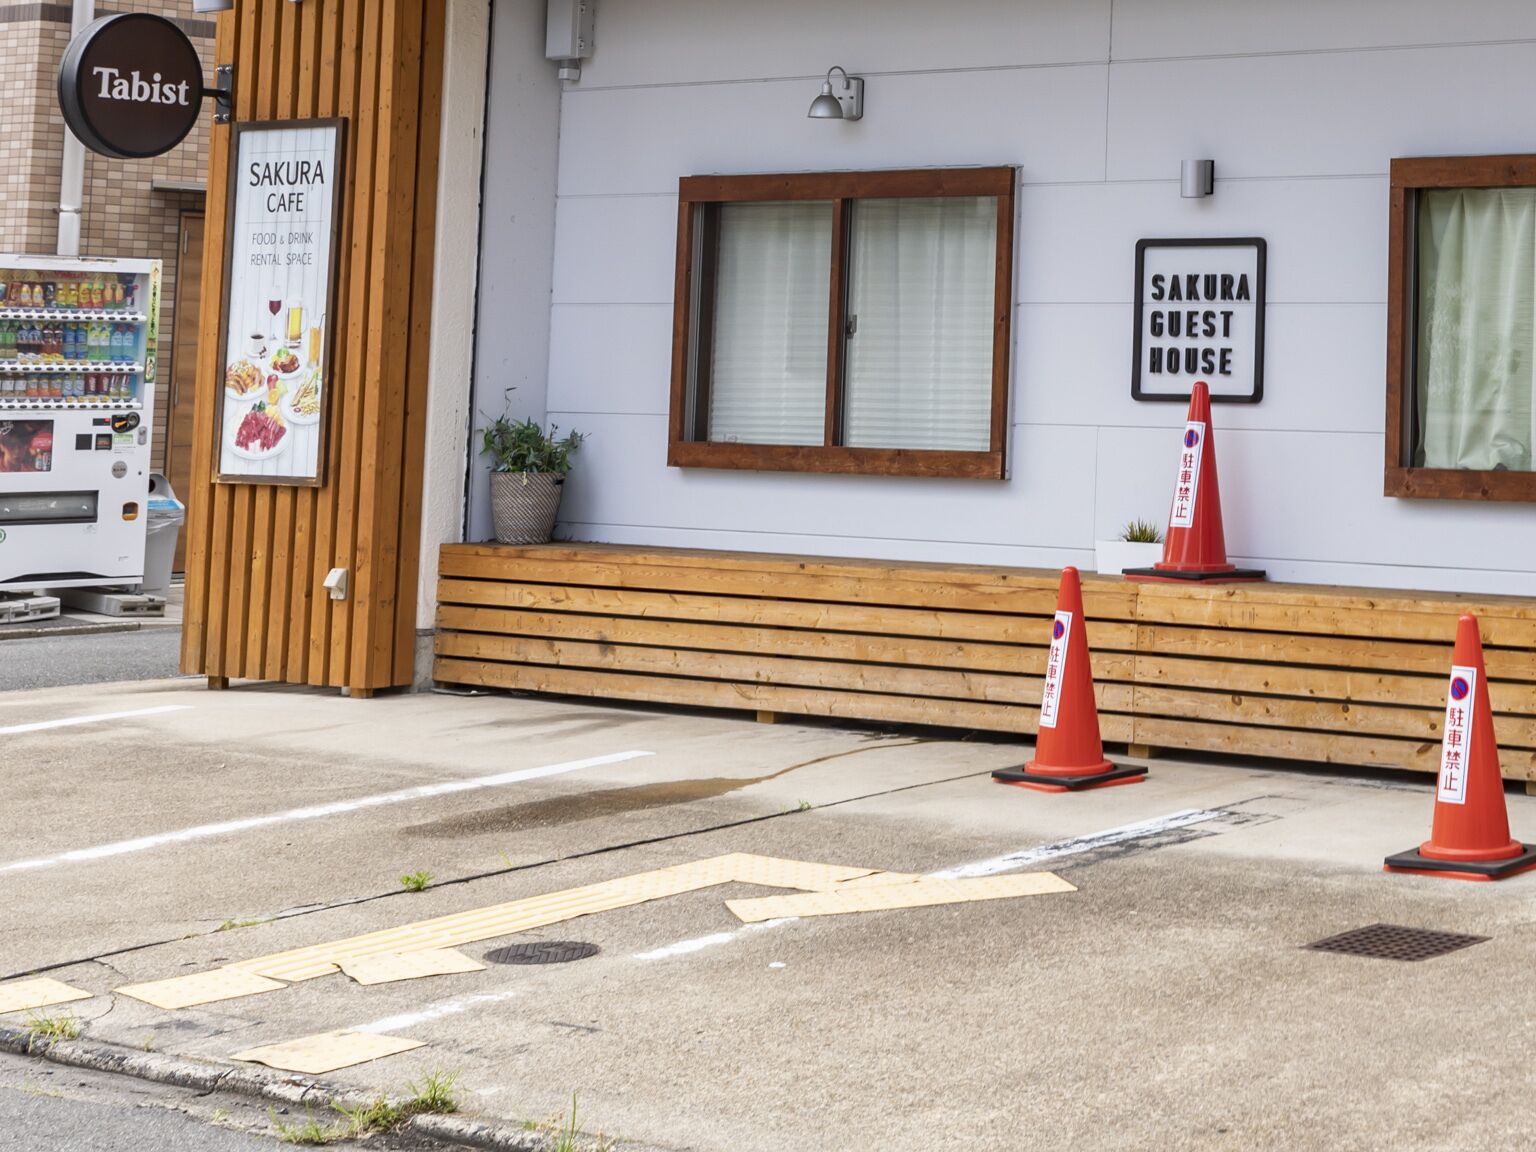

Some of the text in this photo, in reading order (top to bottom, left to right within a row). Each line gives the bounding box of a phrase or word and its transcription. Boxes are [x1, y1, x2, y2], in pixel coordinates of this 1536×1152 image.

[92, 66, 190, 106] Tabist
[249, 160, 325, 187] SAKURA
[266, 192, 304, 213] CAFE
[251, 232, 314, 246] FOOD & DRINK
[250, 253, 313, 266] RENTAL SPACE
[1150, 273, 1251, 302] SAKURA
[1149, 310, 1234, 338] GUEST
[1149, 347, 1233, 376] HOUSE
[1175, 452, 1194, 519] 駐車禁止
[1043, 645, 1060, 718] 駐車禁止
[1443, 707, 1465, 792] 駐車禁止
